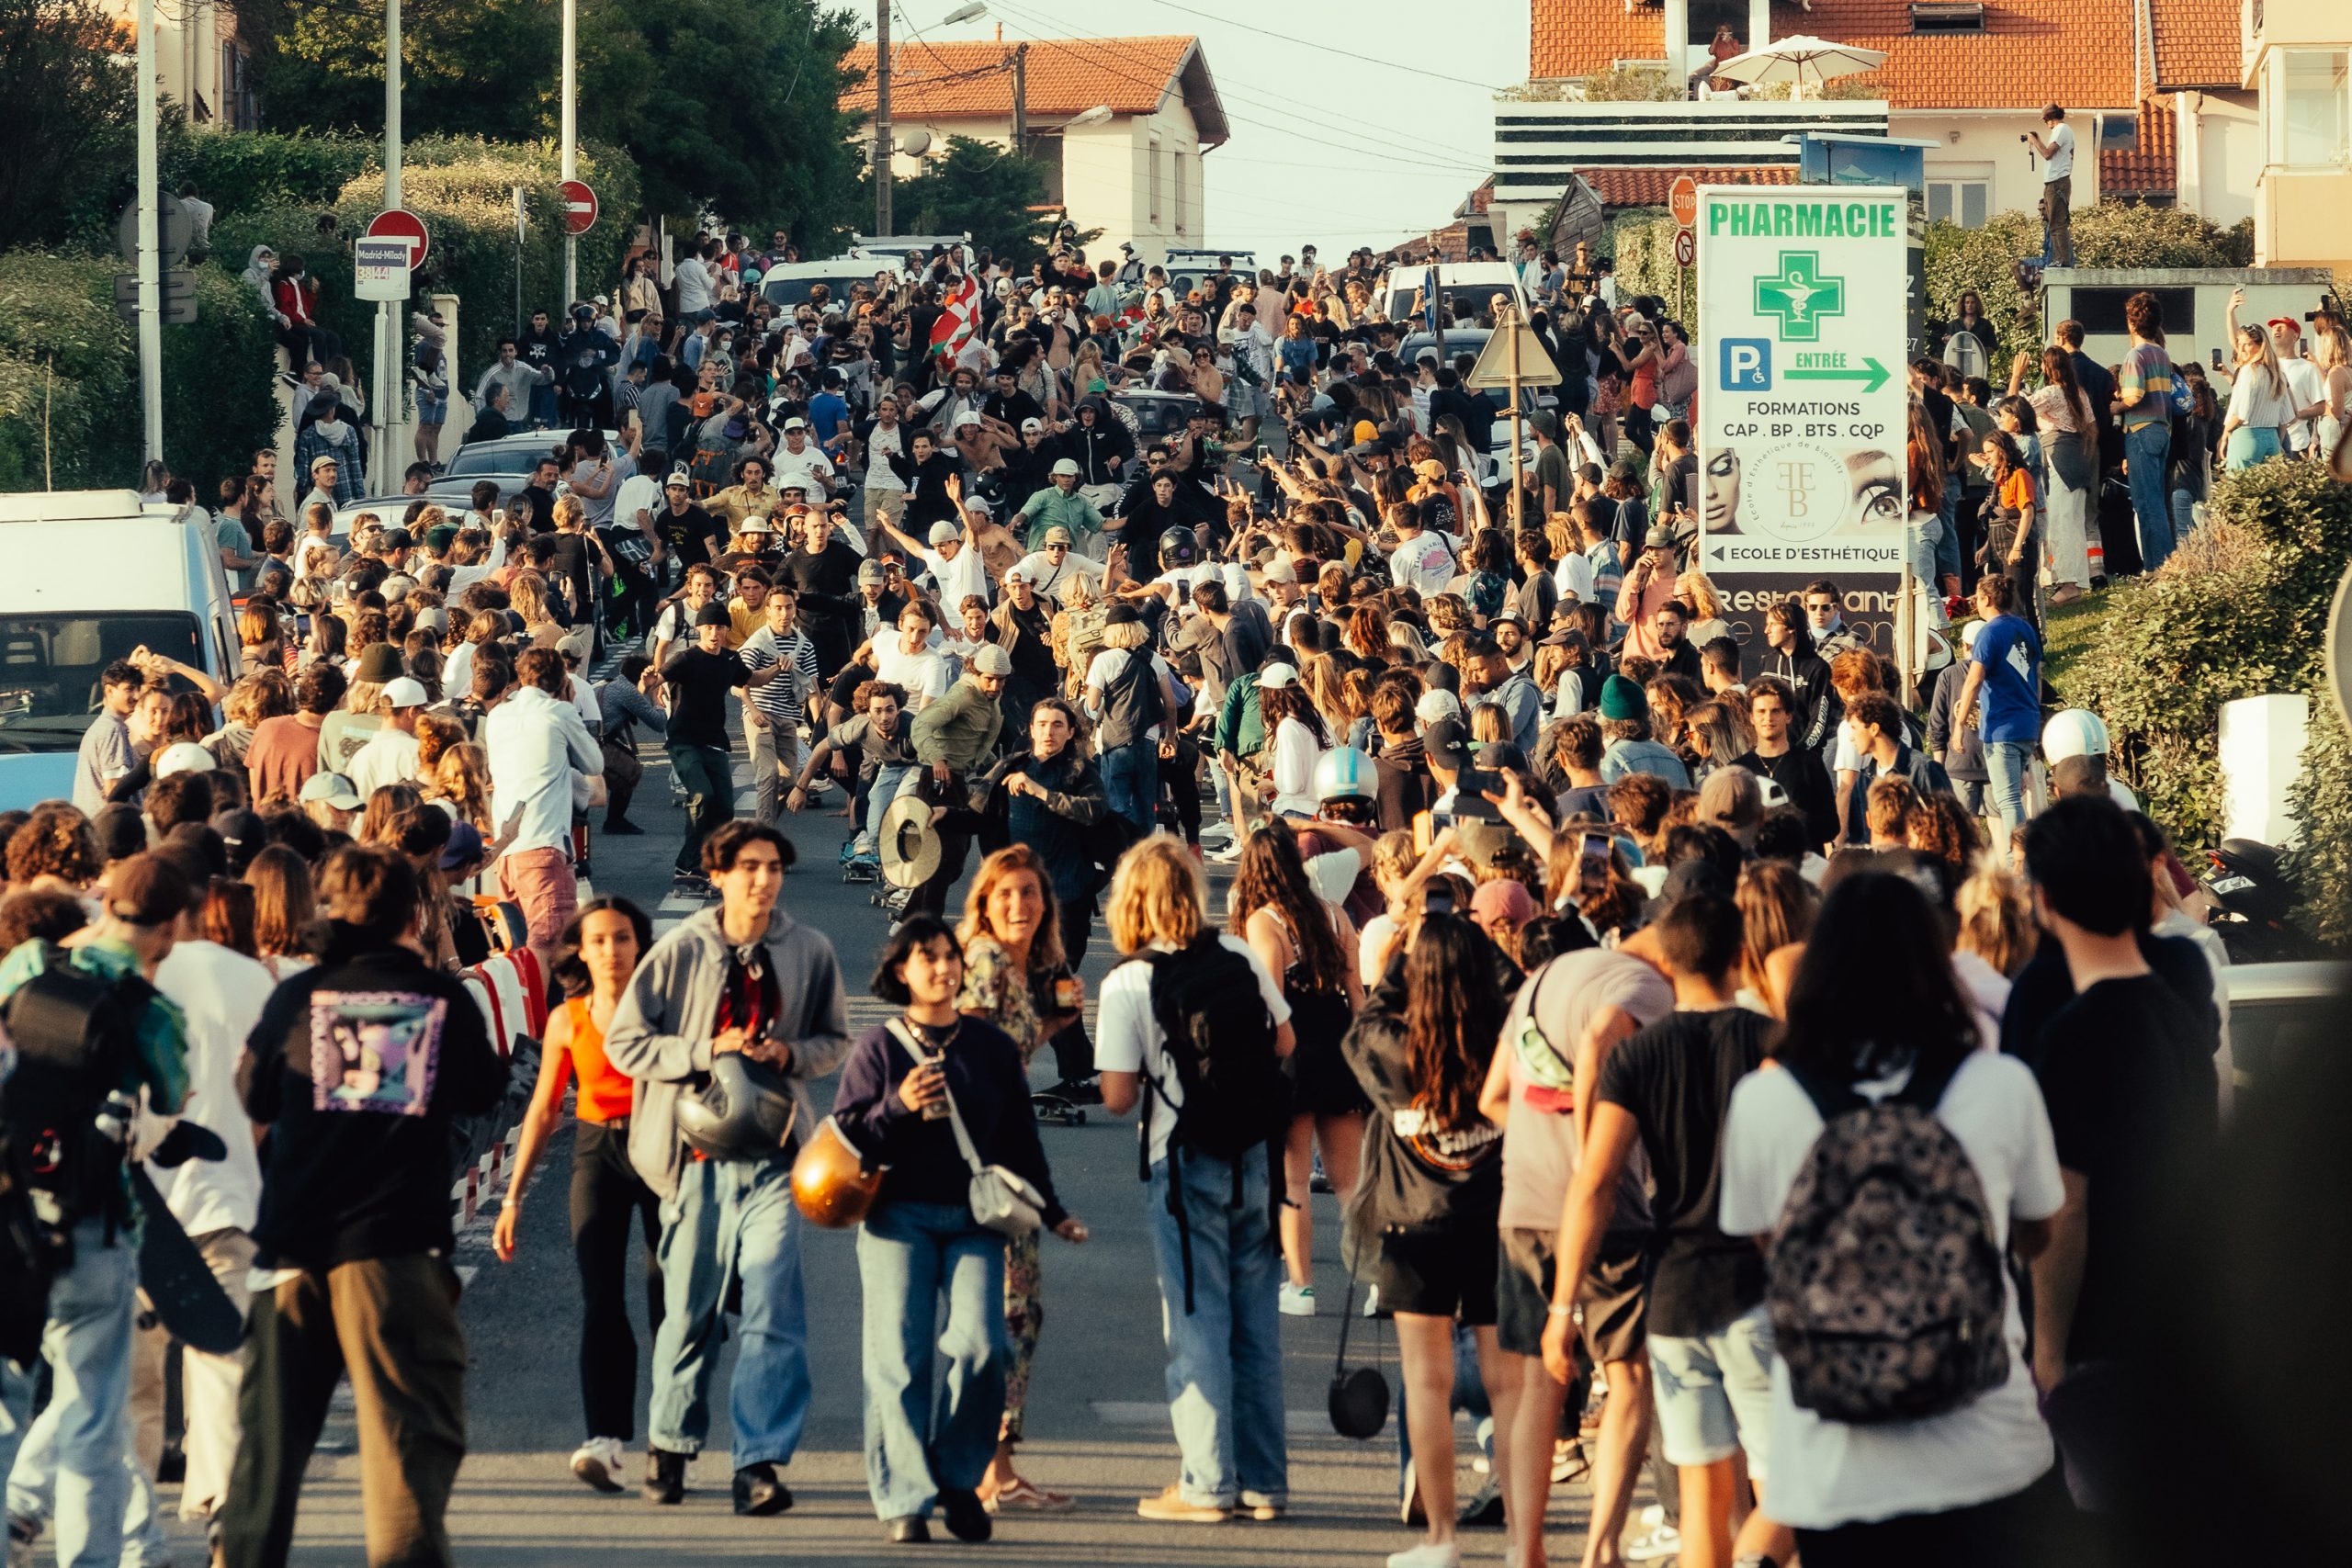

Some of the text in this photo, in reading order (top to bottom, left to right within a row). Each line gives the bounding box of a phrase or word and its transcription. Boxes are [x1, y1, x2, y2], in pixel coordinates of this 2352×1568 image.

[1674, 194, 1696, 209] STOP
[1709, 203, 1895, 238] PHARMACIE
[358, 250, 406, 263] Madrid-Milady
[358, 267, 372, 279] 38
[1730, 345, 1761, 384] P
[1795, 350, 1847, 368] ENTRÉE
[1747, 401, 1860, 416] FORMATIONS
[1724, 423, 1884, 440] CAP BP BTS CQP
[1731, 546, 1900, 562] ECOLE D'ESTHÉTIQUE
[1716, 590, 1896, 613] Restaant
